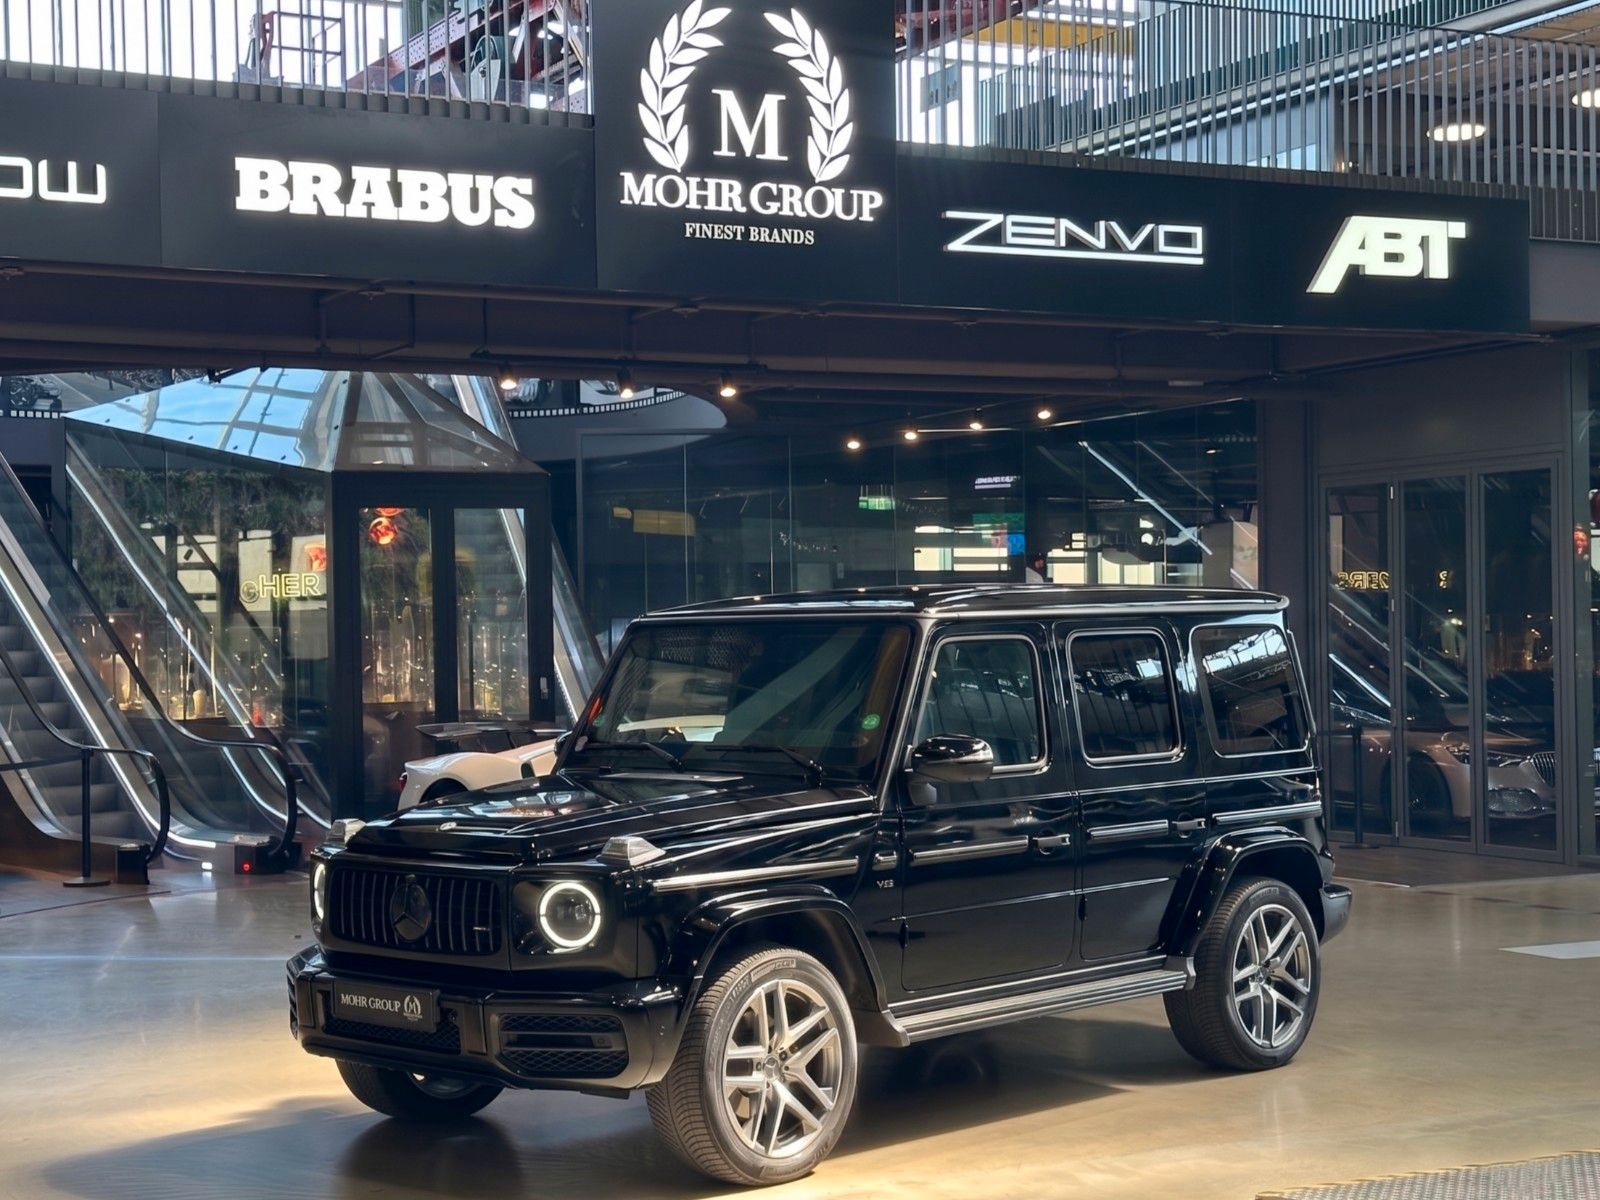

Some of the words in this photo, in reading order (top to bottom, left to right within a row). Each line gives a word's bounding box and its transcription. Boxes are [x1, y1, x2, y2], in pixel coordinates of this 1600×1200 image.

[711, 88, 788, 161] M
[234, 156, 536, 230] BRABUS
[619, 171, 747, 213] MOHR
[749, 181, 884, 222] GROUP
[684, 222, 745, 241] FINEST
[748, 226, 815, 245] BRANDS
[942, 210, 1205, 265] ZENVO
[1306, 215, 1467, 294] ABT
[340, 993, 368, 1009] MOHR
[368, 997, 401, 1013] GROUP
